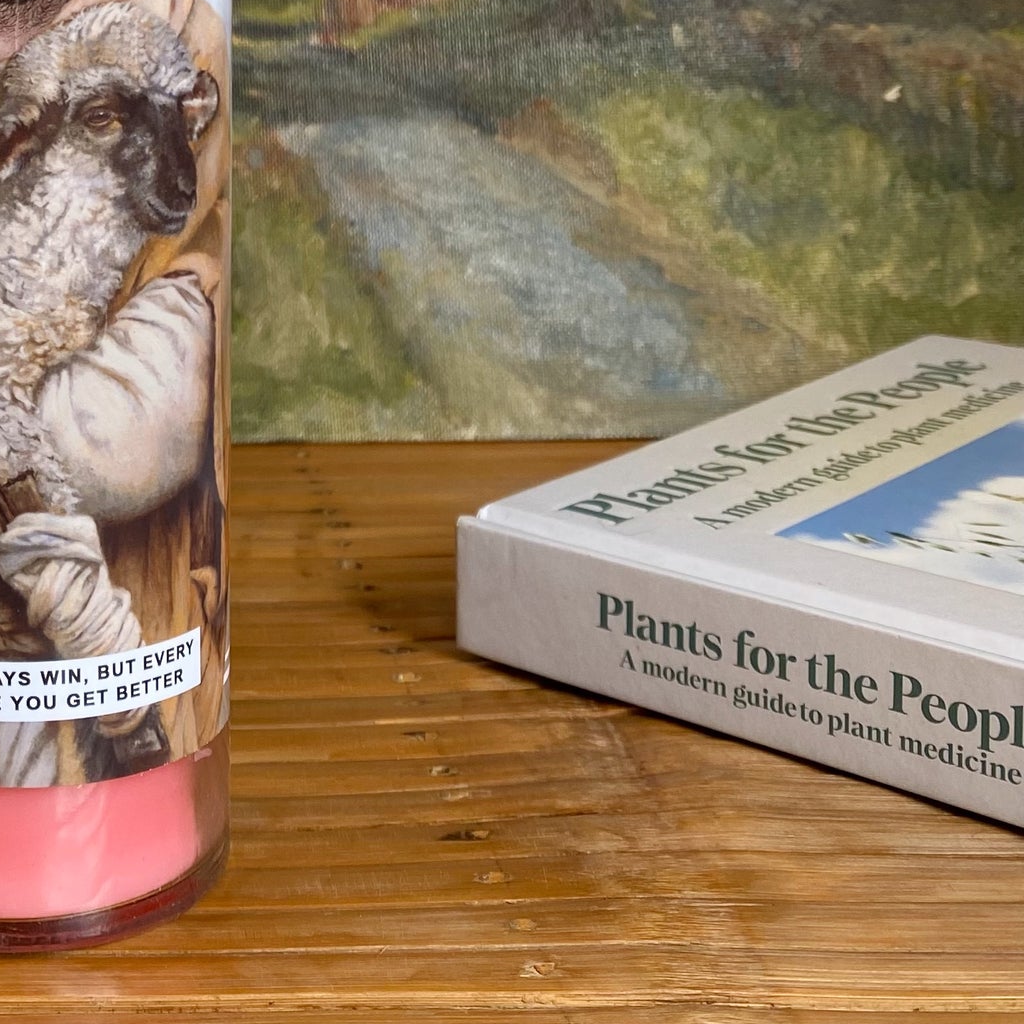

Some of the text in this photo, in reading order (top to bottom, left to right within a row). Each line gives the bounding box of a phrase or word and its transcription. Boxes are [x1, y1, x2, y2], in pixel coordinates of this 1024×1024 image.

[558, 358, 987, 526] Plants for the People
[693, 517, 736, 530] A
[722, 477, 823, 518] modern
[812, 451, 882, 481] guide
[890, 417, 954, 446] plant
[941, 381, 1024, 420] medicine
[10, 694, 57, 711] YOU
[66, 690, 107, 709] GET
[116, 667, 185, 702] BETTER
[41, 667, 89, 687] WIN,
[98, 661, 136, 681] BUT
[142, 638, 195, 671] EVERY
[596, 592, 1024, 754] Plants for the Peopl
[619, 649, 1023, 786] A modern guide to plant medicine
